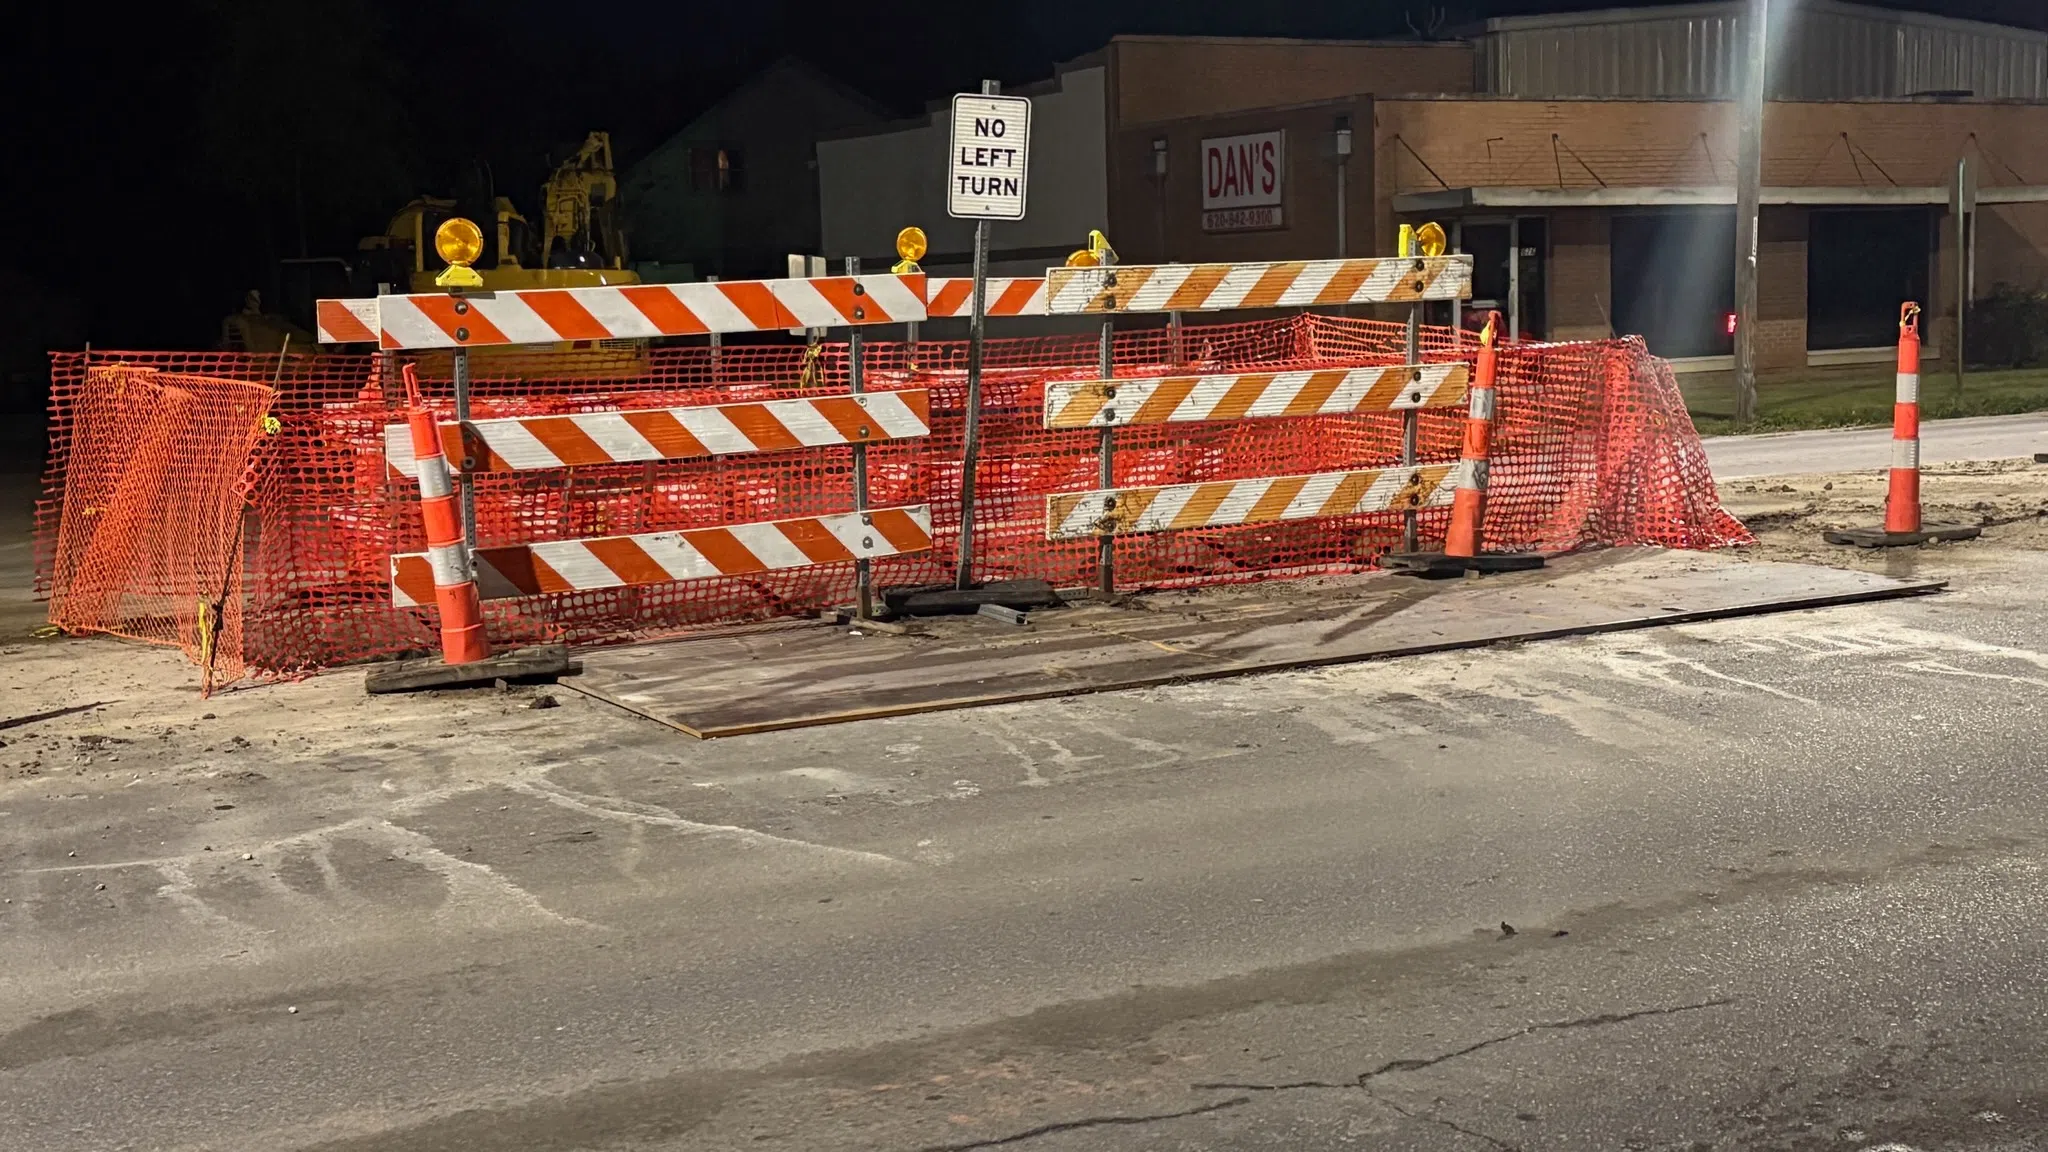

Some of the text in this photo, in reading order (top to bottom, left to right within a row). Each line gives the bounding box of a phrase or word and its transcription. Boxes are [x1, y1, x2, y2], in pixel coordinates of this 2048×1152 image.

[975, 118, 1005, 138] NO
[961, 147, 1016, 167] LEFT
[1208, 141, 1275, 198] DAN'S
[957, 176, 1018, 196] TURN
